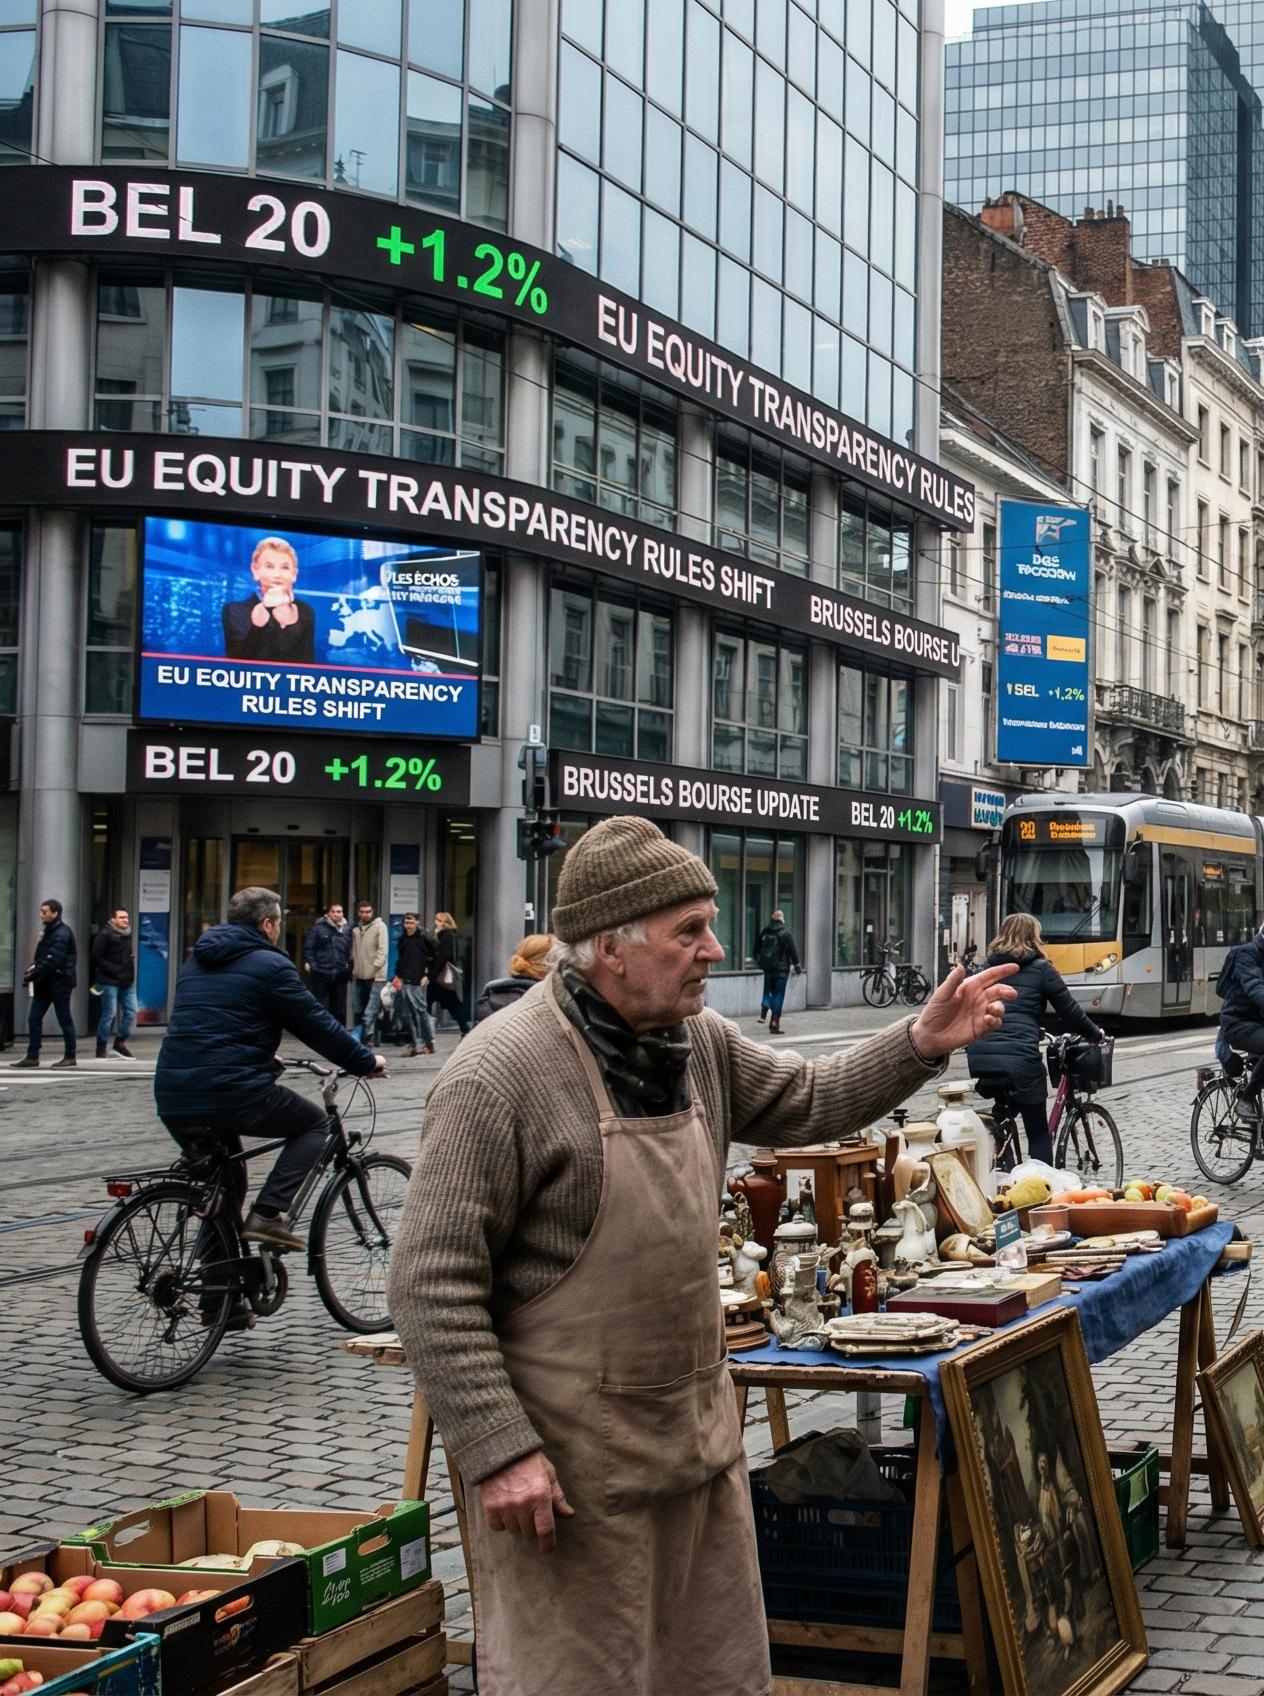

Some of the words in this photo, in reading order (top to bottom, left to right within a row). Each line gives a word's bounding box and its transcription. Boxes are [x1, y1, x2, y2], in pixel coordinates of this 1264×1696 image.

[71, 180, 221, 244] BEL
[245, 195, 331, 258] 20
[377, 226, 548, 315] +1.2%
[598, 294, 638, 354] EU
[647, 321, 744, 406] EQUITY
[749, 376, 917, 494] TRANSPARENCY
[920, 468, 975, 524] RULES
[67, 449, 134, 488] EU
[153, 452, 346, 503] EQUITY
[359, 470, 638, 566] TRANSPARENCY
[643, 538, 715, 591] RULES
[720, 566, 775, 609] SHIFT
[392, 571, 414, 585] LES
[414, 571, 460, 587] ÉCHOS
[811, 596, 891, 646] BRUSSELS
[895, 624, 949, 664] BOURSE
[158, 665, 190, 685] EU
[196, 668, 281, 690] EQUITY
[286, 674, 463, 703] TRANSPARENCY
[242, 694, 317, 716] RULES
[322, 699, 386, 720] SHIFT
[145, 745, 234, 781] BEL
[246, 750, 296, 784] 20
[324, 755, 442, 791] +1.2%
[563, 765, 674, 806] BRUSSELS
[678, 780, 753, 814] BOURSE
[757, 789, 820, 821] UPDATE
[851, 801, 878, 828] BEL
[879, 806, 895, 830] 20
[897, 810, 933, 834] +1.2%
